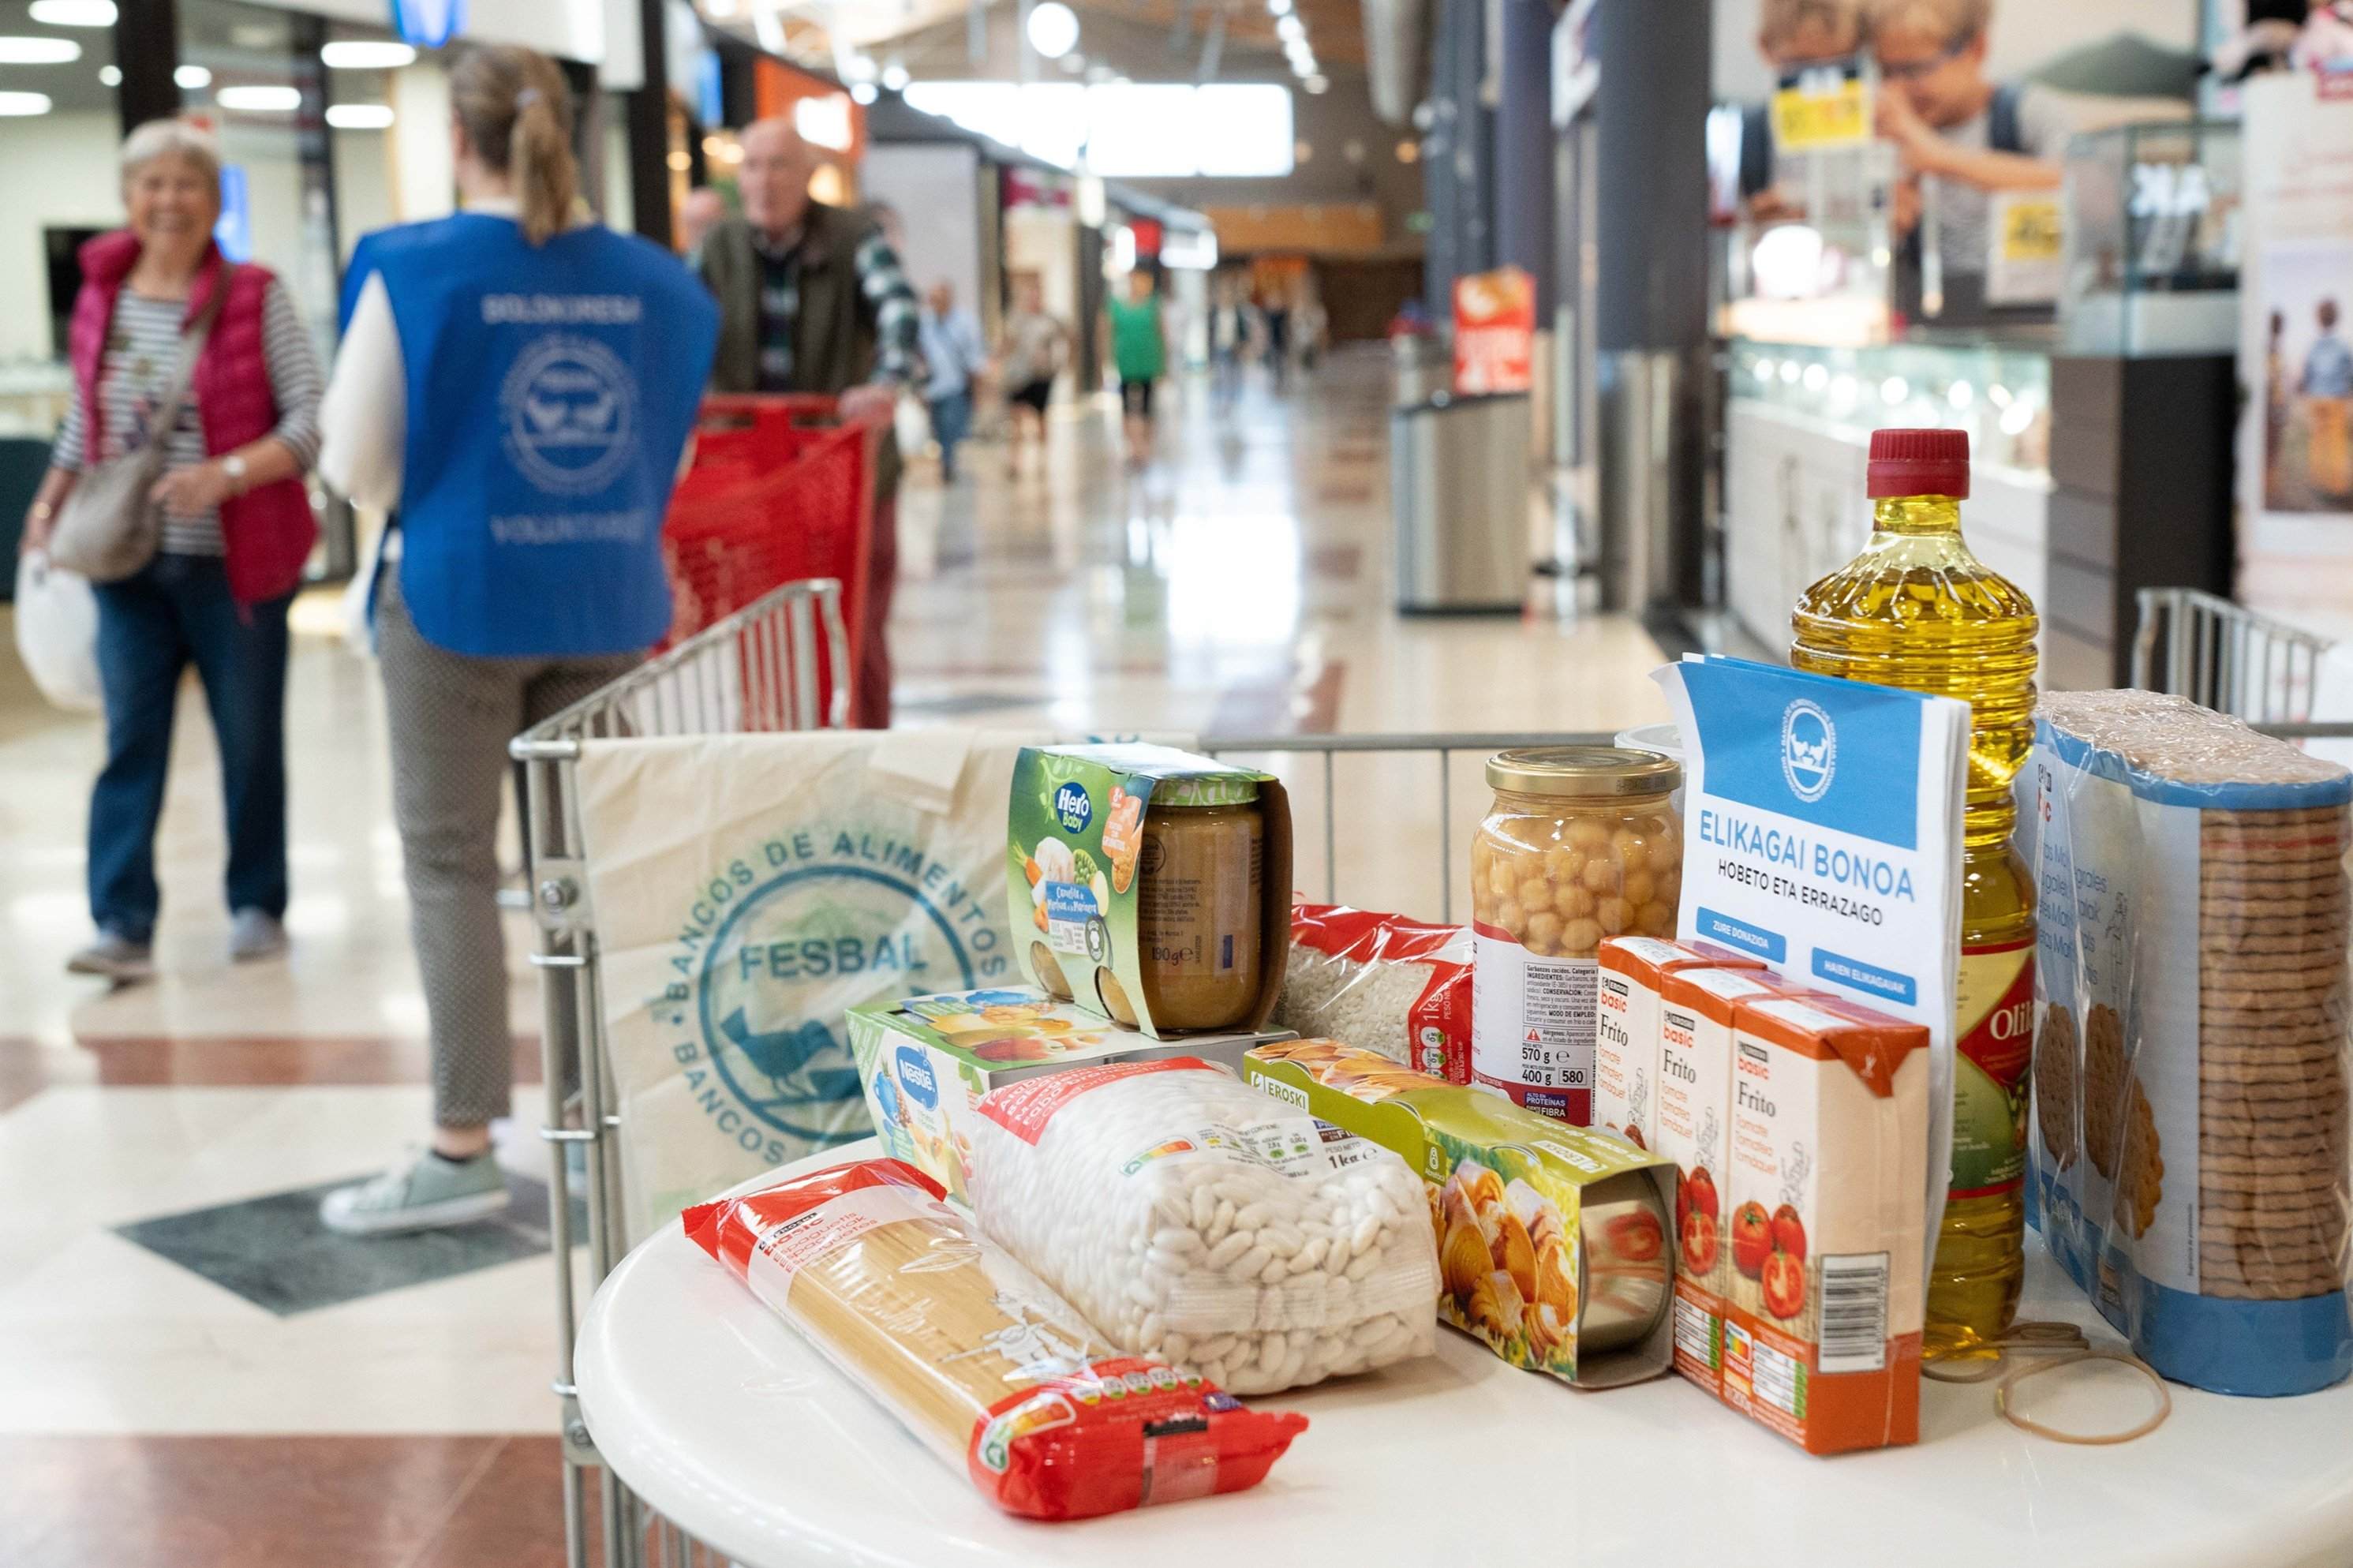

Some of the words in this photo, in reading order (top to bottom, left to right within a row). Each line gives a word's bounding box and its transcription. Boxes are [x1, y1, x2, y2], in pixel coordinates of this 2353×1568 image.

[1057, 788, 1090, 817] Hero
[1062, 811, 1083, 833] Baby
[1700, 809, 1805, 871] ELIKAGAI
[1814, 843, 1916, 904] BONOA
[1718, 858, 1769, 891] HOBETO
[1773, 877, 1797, 900] ETA
[1801, 885, 1884, 926] ERRAZAGO
[666, 859, 755, 1001] BANCOS
[765, 833, 817, 867] DE
[832, 830, 1007, 978] ALIMENTOS
[1712, 920, 1731, 936] ZURE
[1732, 926, 1770, 950] DONAZIOA
[739, 933, 929, 982] FESBAL
[1600, 990, 1628, 1013] basic
[1599, 1013, 1629, 1047] Frito
[1663, 1024, 1694, 1049] basic
[1522, 1047, 1540, 1061] 570
[1543, 1051, 1550, 1065] g
[1663, 1049, 1696, 1084] Frito
[1738, 1057, 1770, 1080] basic
[899, 1058, 933, 1091] Nestlé
[1522, 1069, 1542, 1083] 400
[1545, 1073, 1552, 1087] g
[1562, 1070, 1584, 1083] 580
[673, 1041, 787, 1166] BANCOS
[1268, 1082, 1306, 1110] EROSKI
[1526, 1097, 1566, 1106] PROTEÍNAS
[1738, 1080, 1776, 1118] Frito
[1541, 1107, 1566, 1117] FIBRA
[1329, 1155, 1338, 1169] 1
